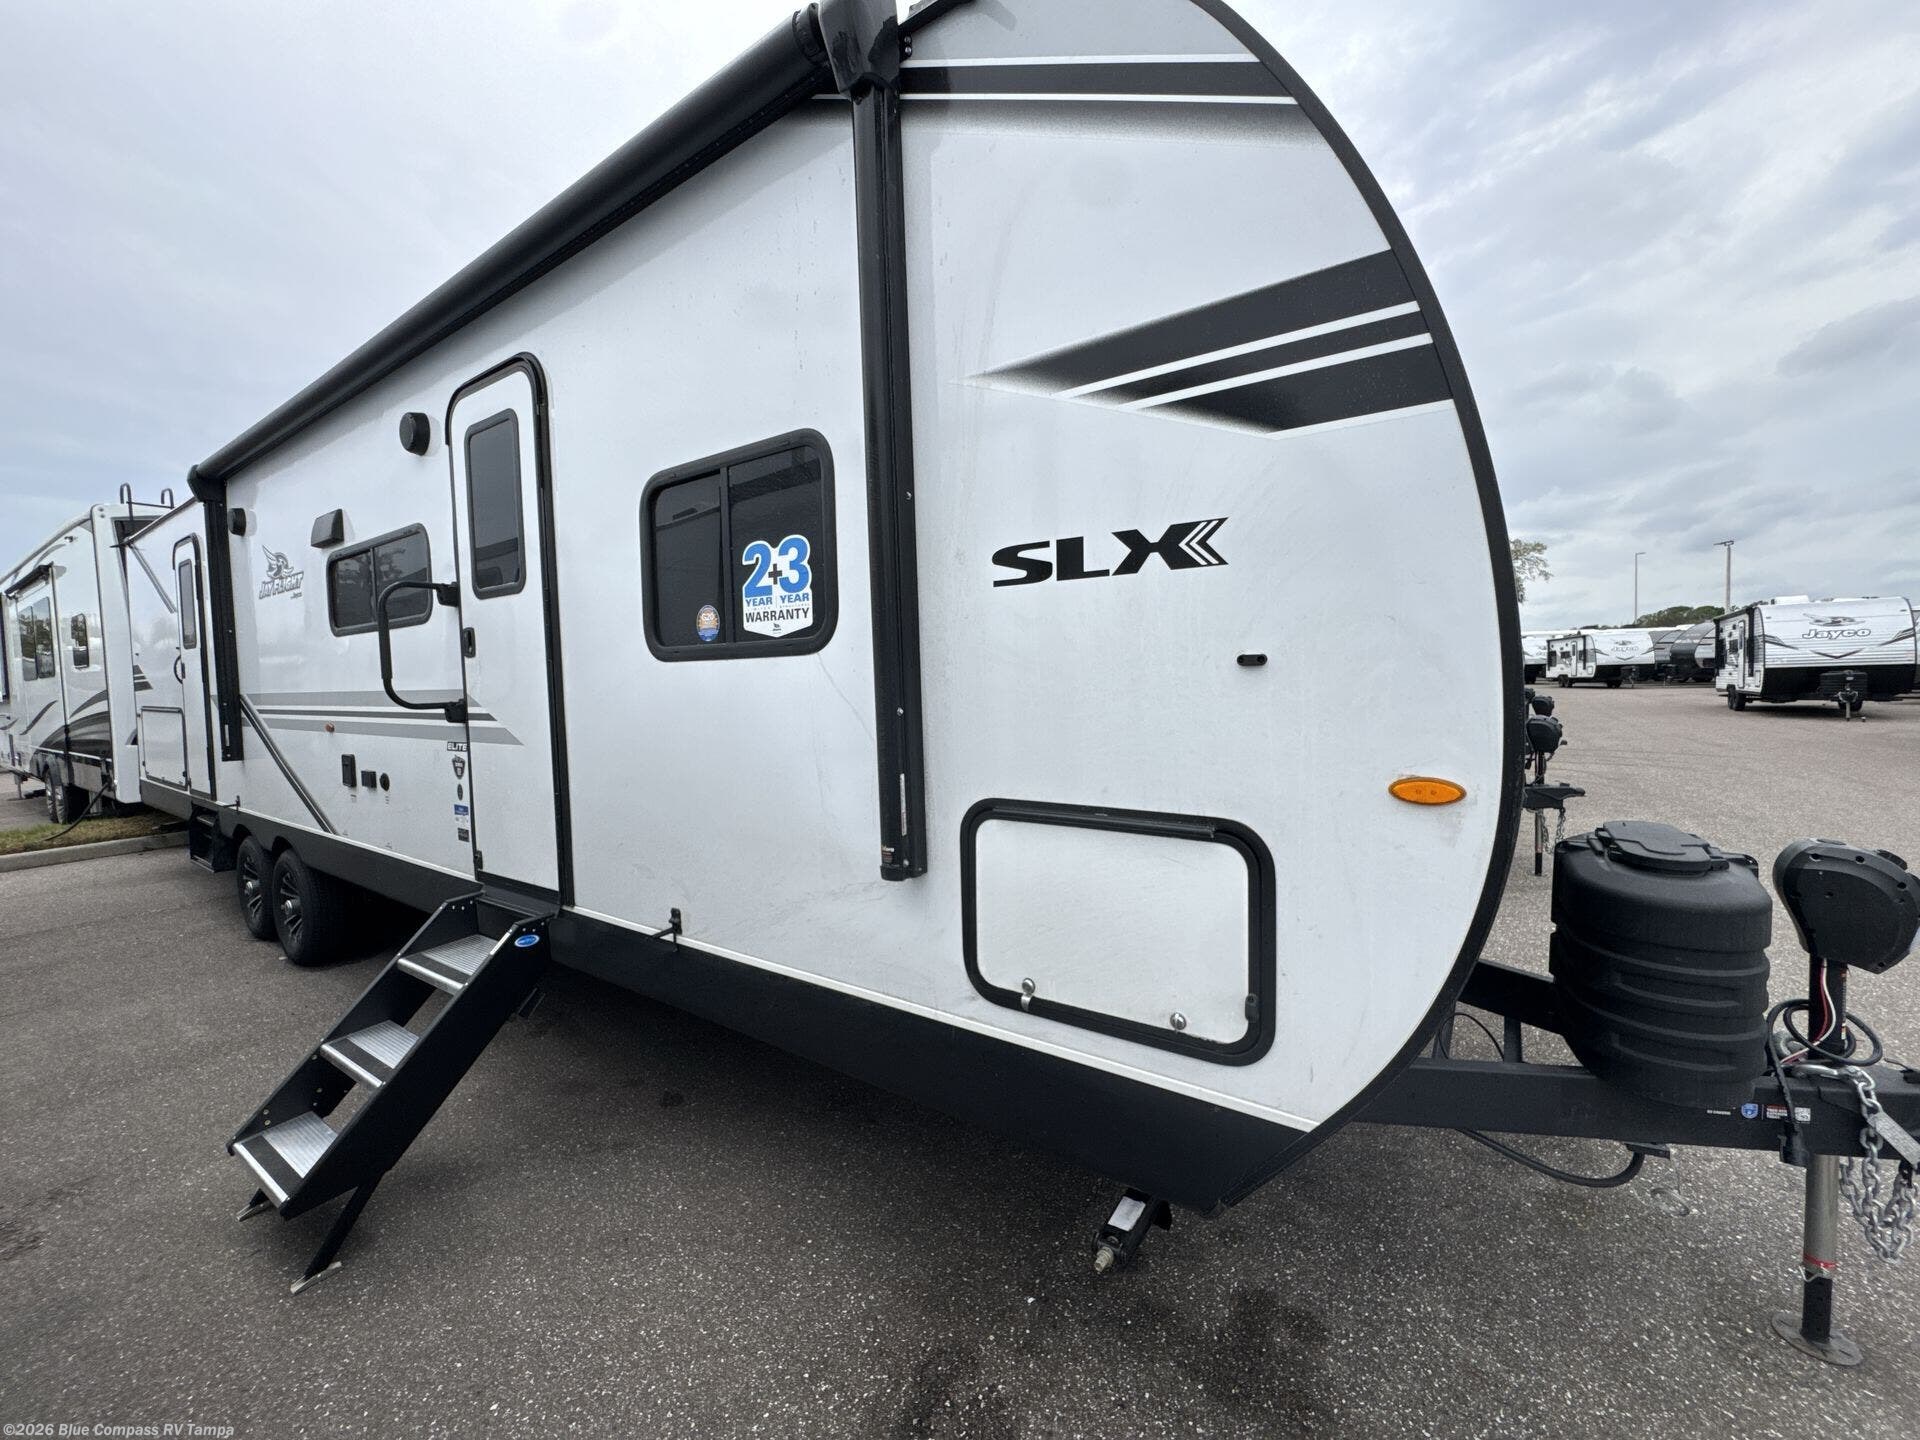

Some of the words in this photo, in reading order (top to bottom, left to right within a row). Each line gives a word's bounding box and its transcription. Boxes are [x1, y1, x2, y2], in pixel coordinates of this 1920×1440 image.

[992, 517, 1229, 587] SLX
[745, 596, 773, 607] YEAR
[780, 592, 810, 604] YEAR
[745, 607, 810, 623] WARRANTY
[1802, 628, 1871, 640] Jayco
[447, 742, 467, 751] ELITE
